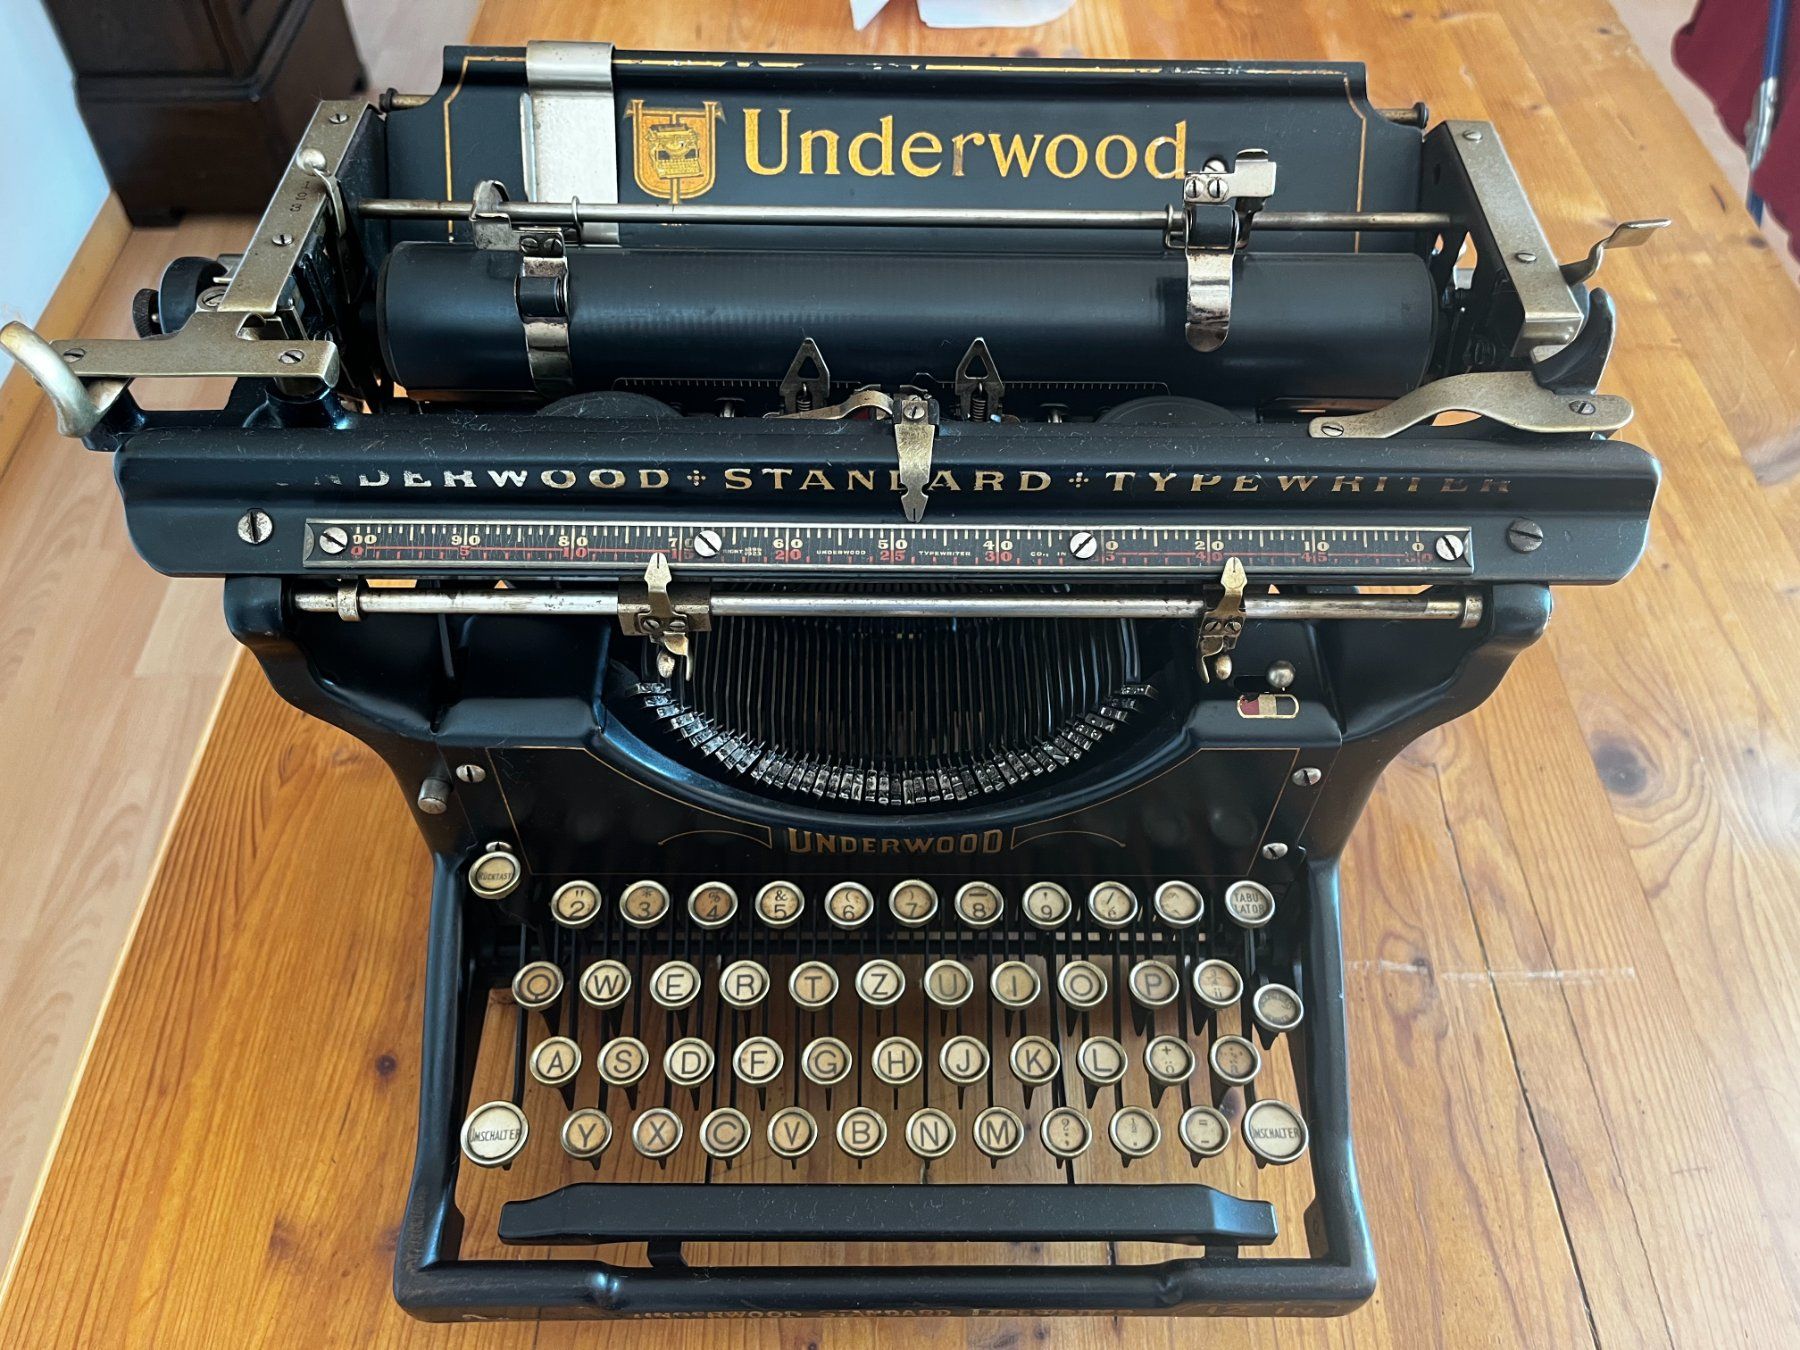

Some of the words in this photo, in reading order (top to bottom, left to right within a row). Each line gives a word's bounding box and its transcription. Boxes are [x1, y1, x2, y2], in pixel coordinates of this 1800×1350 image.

[742, 107, 1187, 180] Underwood
[312, 469, 670, 488] DERWOOD
[451, 535, 481, 546] 90
[558, 536, 589, 548] 80
[772, 538, 803, 550] 60
[878, 539, 908, 550] 50
[983, 540, 1013, 551] 40
[1194, 541, 1225, 551] 20
[774, 550, 803, 561] 20
[879, 550, 907, 562] 25
[984, 551, 1013, 562] 30
[788, 827, 1004, 854] UNDERWOOD
[774, 889, 788, 902] &
[569, 901, 587, 918] 2
[638, 901, 651, 917] 3
[706, 904, 719, 920] 4
[774, 903, 787, 919] 5
[842, 904, 855, 920] 6
[906, 903, 918, 917] 7
[972, 902, 986, 918] 8
[1040, 904, 1053, 919] 9
[593, 974, 620, 996] W
[665, 973, 685, 997] E
[735, 974, 755, 996] R
[804, 975, 823, 999] T
[870, 973, 889, 996] Z
[938, 973, 958, 998] U
[1012, 975, 1018, 997] I
[1069, 973, 1094, 997] O
[1144, 972, 1163, 996] P
[546, 1049, 565, 1074] A
[613, 1049, 633, 1074] S
[681, 1050, 701, 1075] D
[749, 1050, 768, 1075] F
[814, 1049, 837, 1075] G
[887, 1049, 907, 1075] H
[955, 1048, 970, 1073] J
[1025, 1048, 1046, 1073] K
[1092, 1048, 1113, 1072] L
[577, 1122, 598, 1148] Y
[646, 1119, 668, 1147] X
[712, 1120, 737, 1145] C
[783, 1121, 801, 1146] V
[852, 1120, 871, 1145] B
[920, 1121, 939, 1147] N
[986, 1119, 1010, 1146] M
